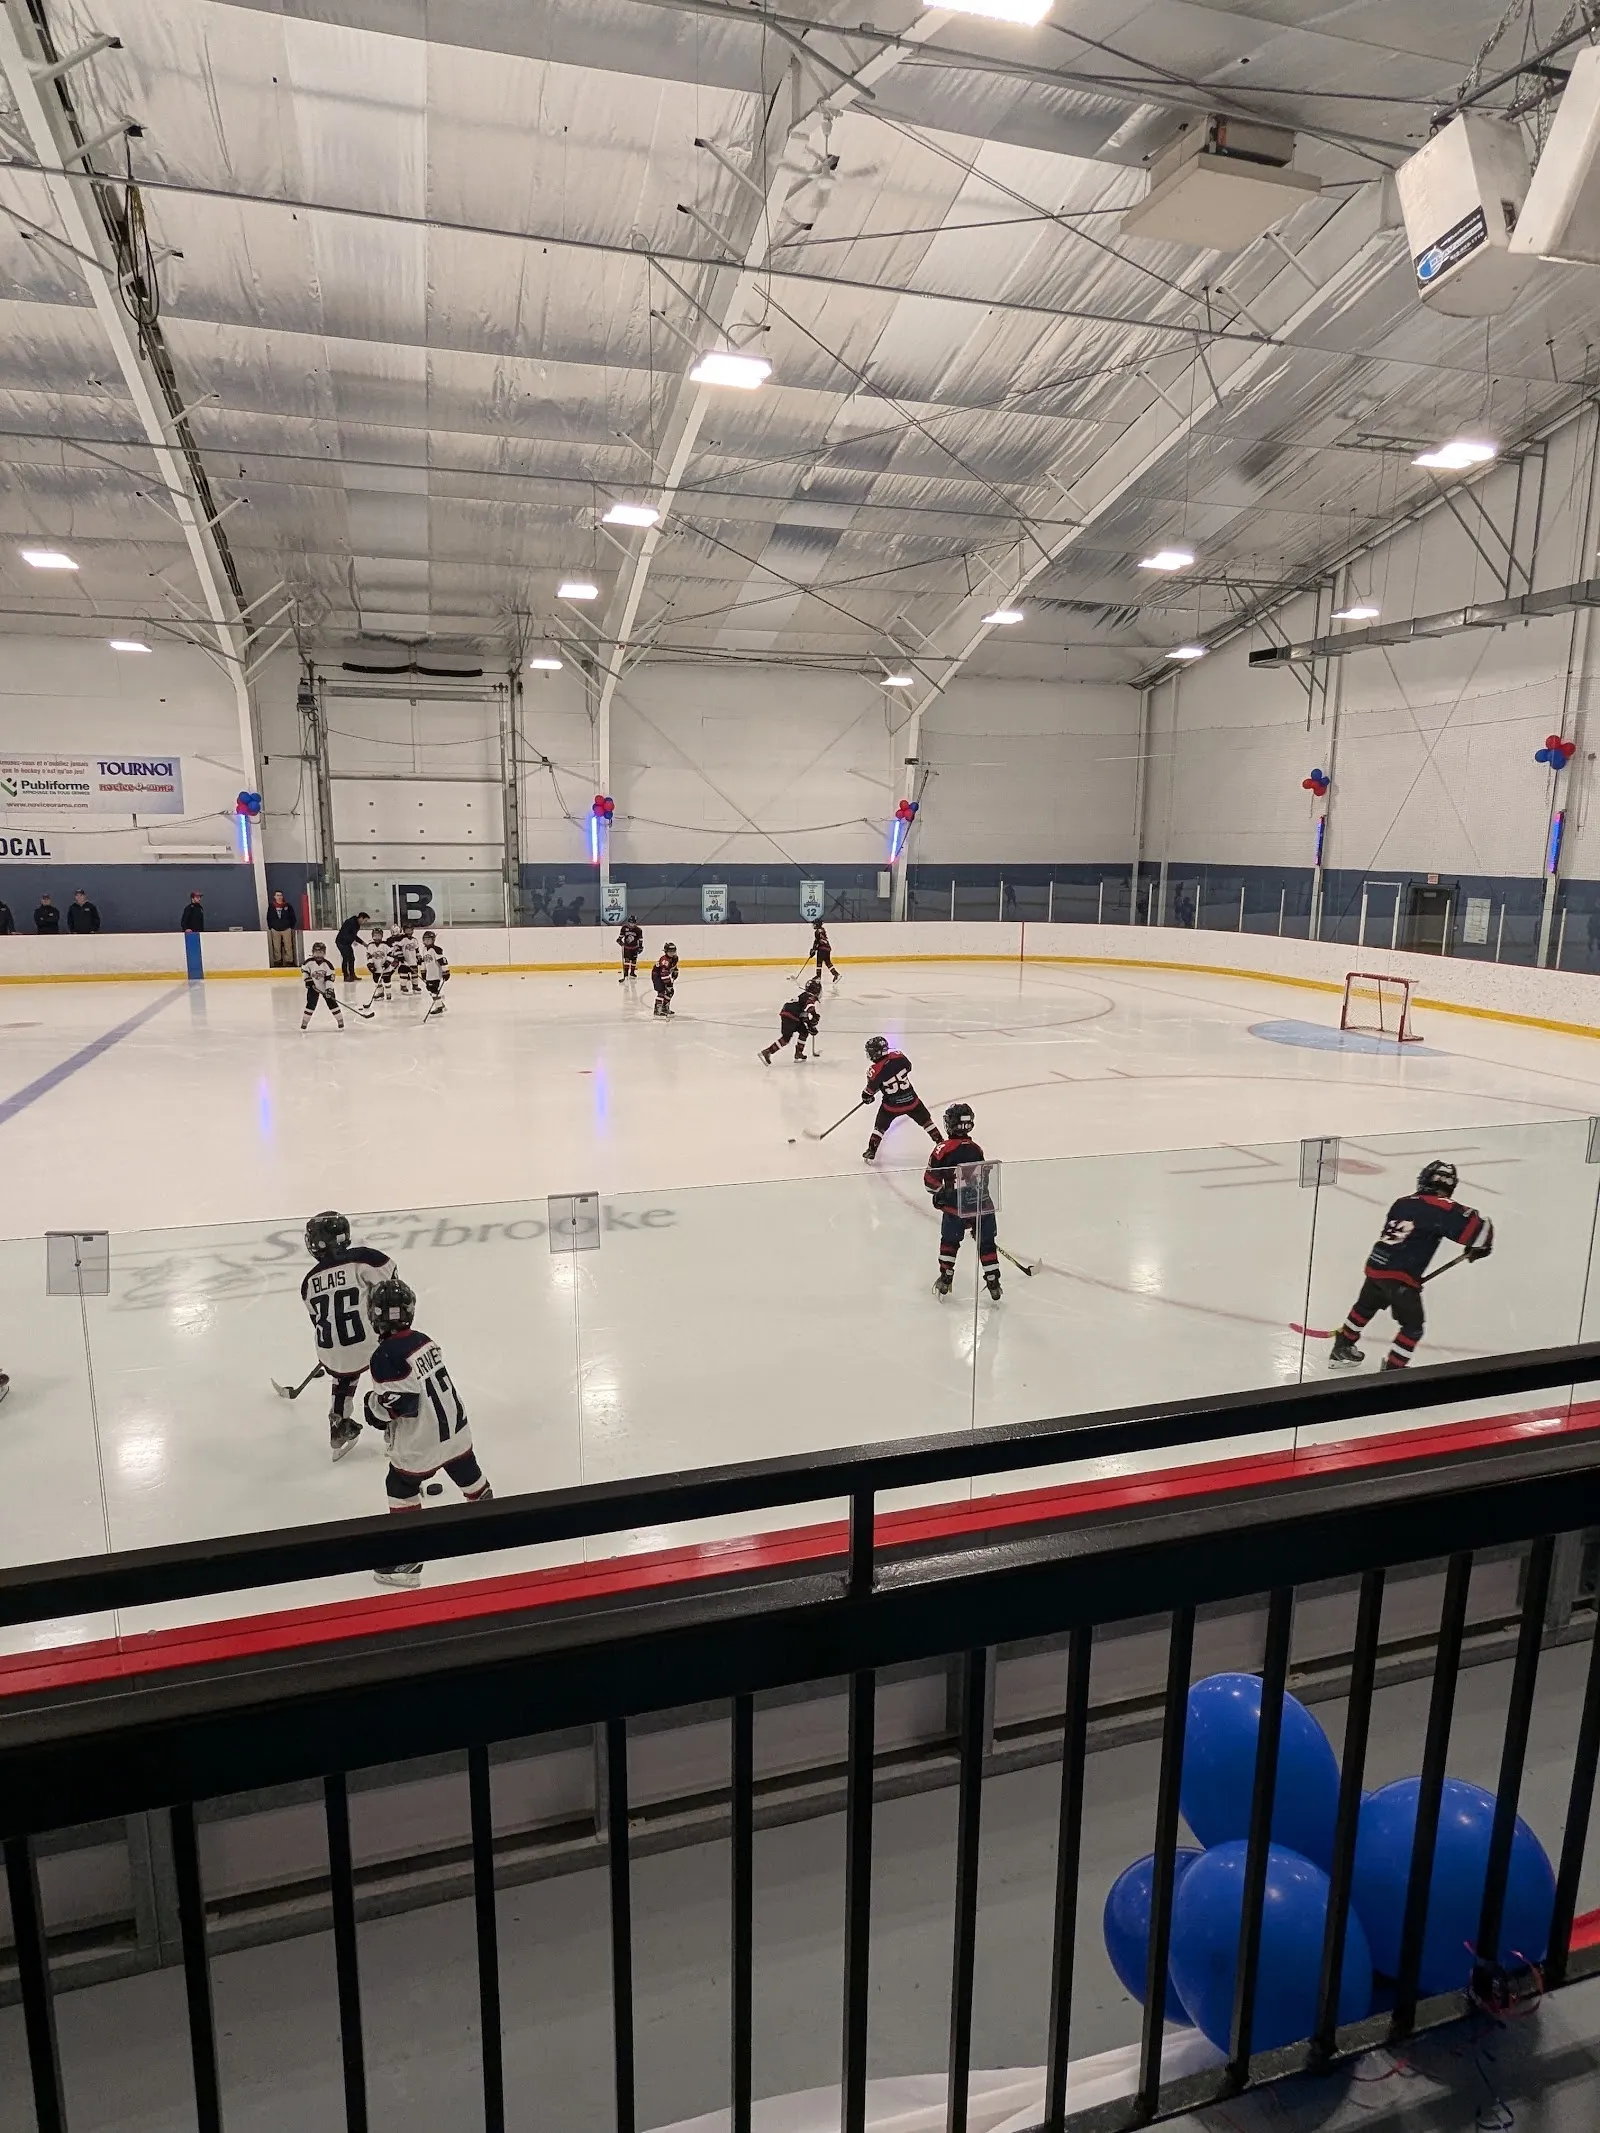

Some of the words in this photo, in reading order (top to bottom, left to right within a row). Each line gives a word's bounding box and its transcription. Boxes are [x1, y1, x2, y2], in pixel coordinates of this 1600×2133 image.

[97, 762, 173, 776] TOURNOI
[21, 780, 90, 791] Publiforme
[392, 884, 436, 928] B
[806, 908, 817, 917] 12
[608, 912, 621, 922] 27
[709, 912, 720, 922] 14
[882, 1067, 911, 1095] 55
[252, 1205, 677, 1263] Serbrooke
[311, 1270, 346, 1294] BLAIS
